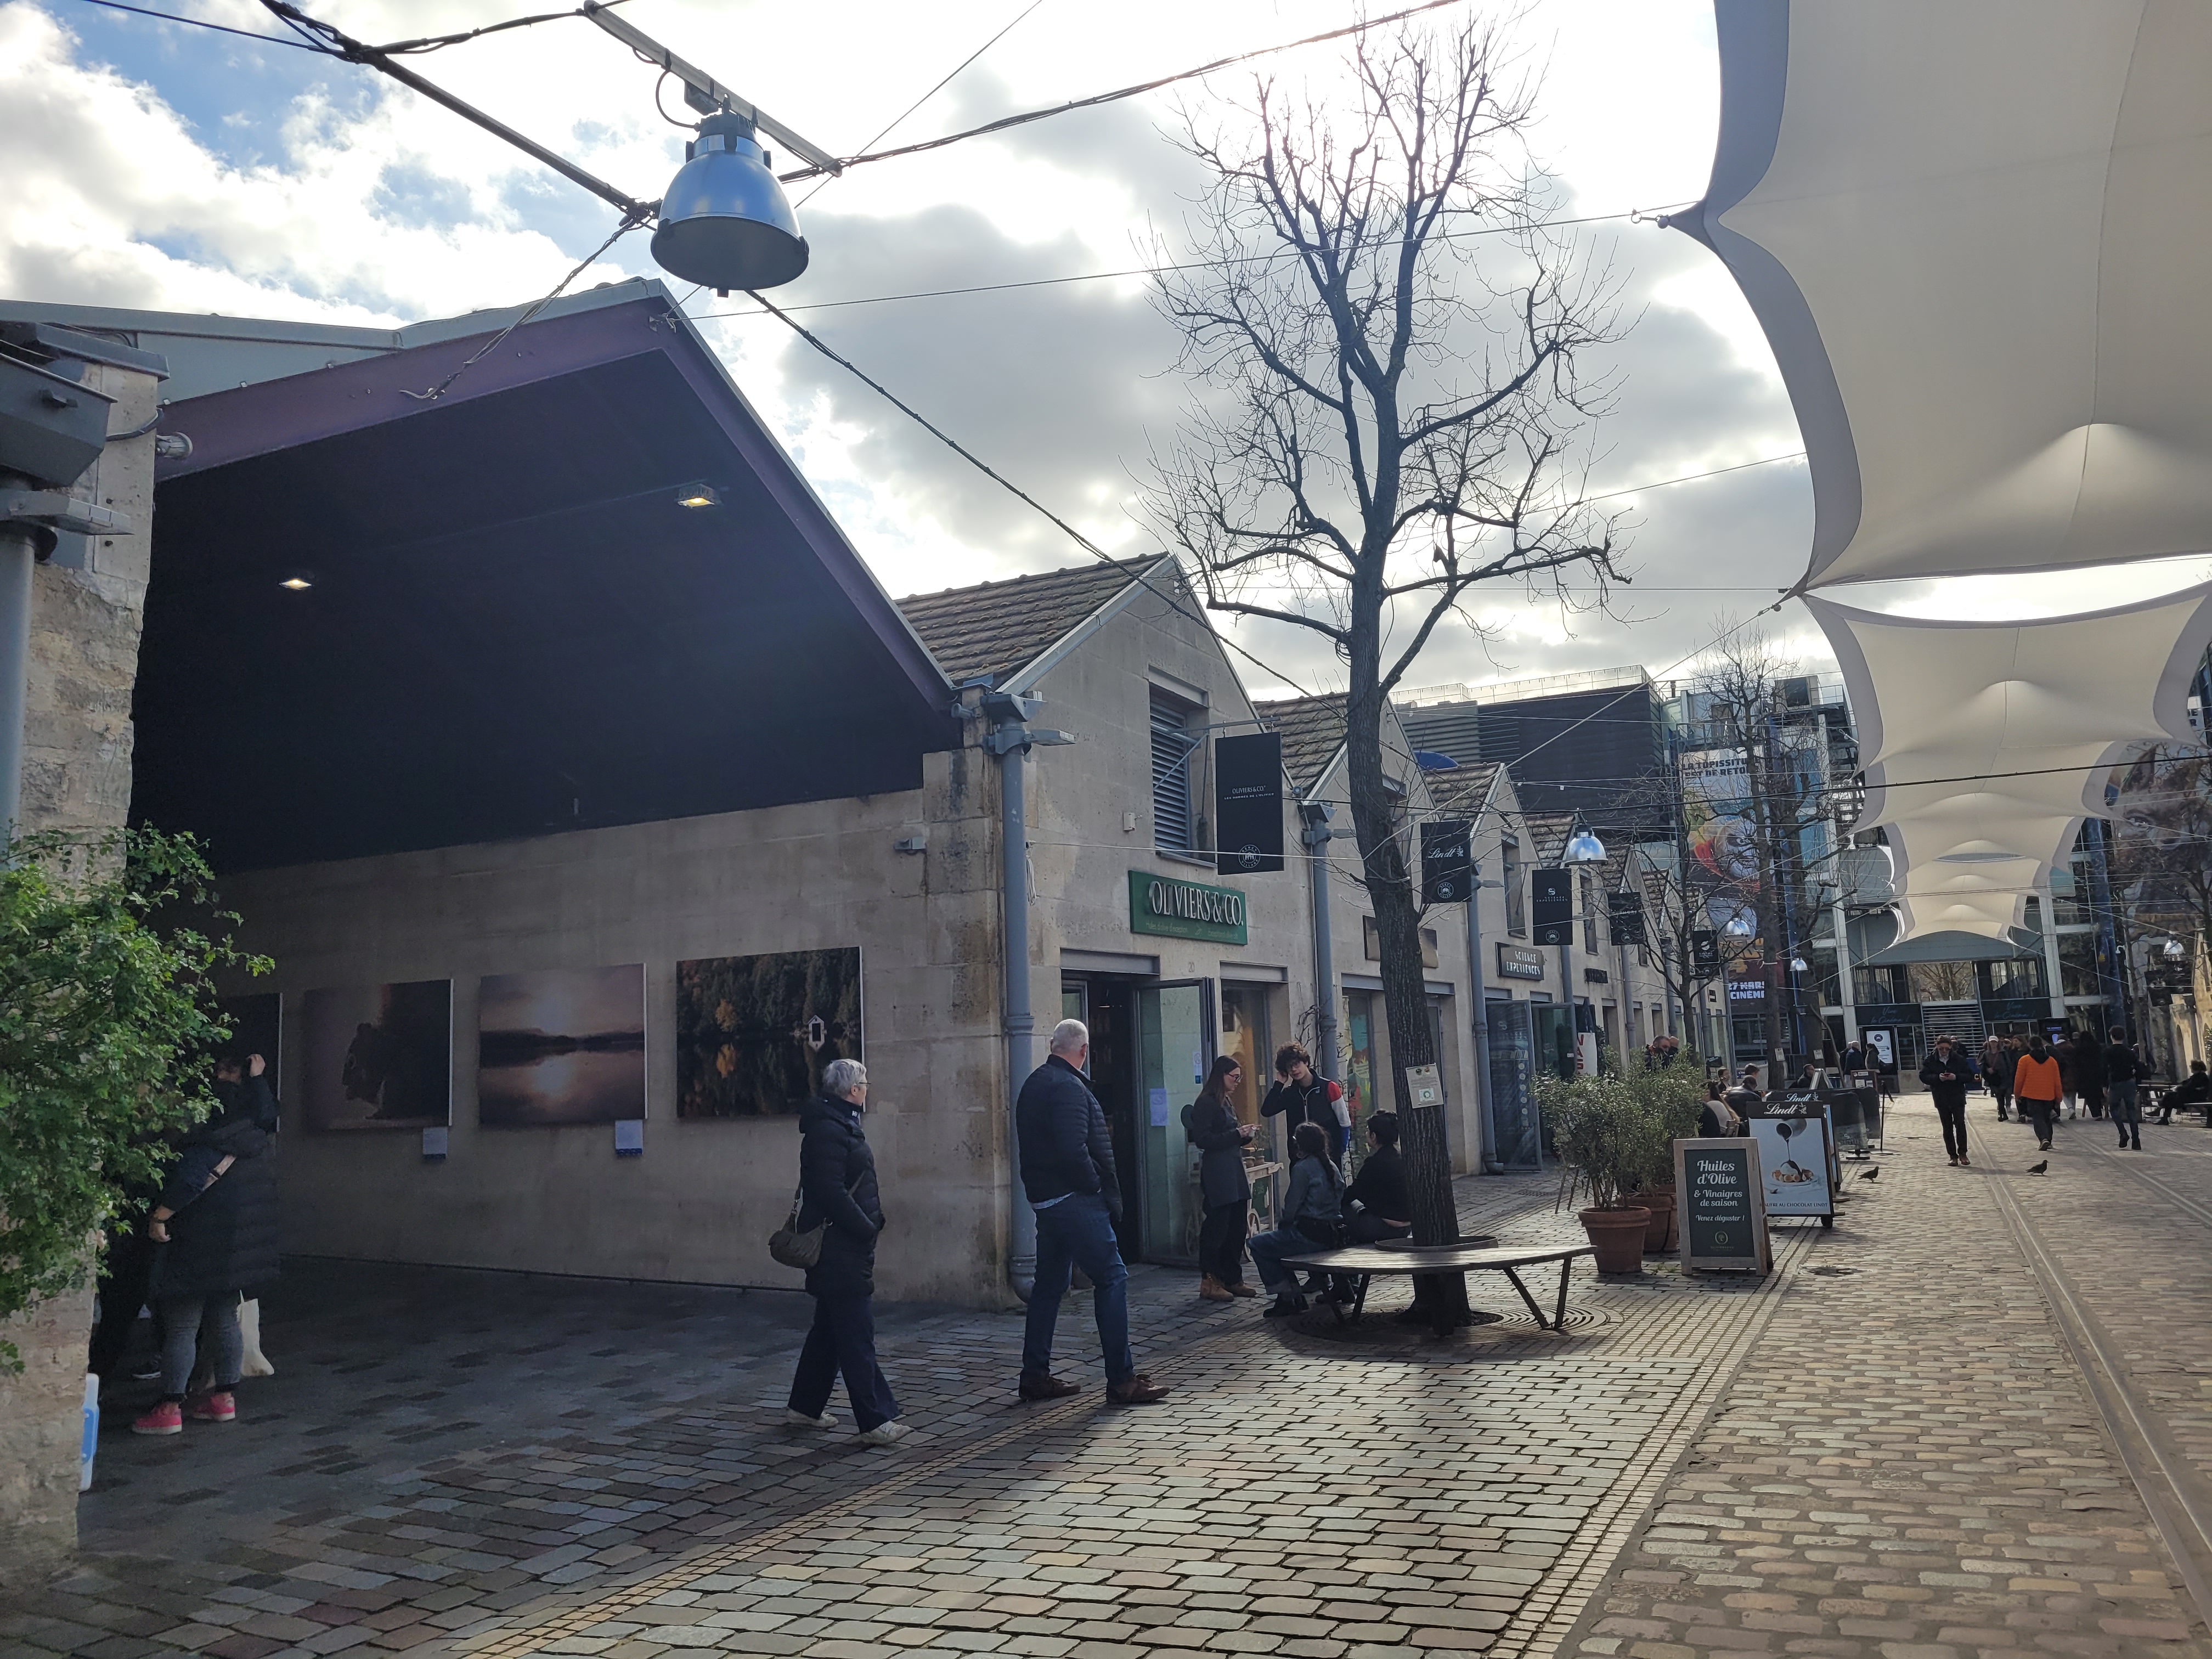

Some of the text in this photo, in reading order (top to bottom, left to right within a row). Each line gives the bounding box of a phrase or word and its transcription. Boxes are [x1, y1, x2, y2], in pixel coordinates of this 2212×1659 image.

[1426, 847, 1456, 859] Lindt
[1515, 950, 1537, 963] SCIENCE
[1506, 961, 1541, 975] EXPERIENCES
[1784, 1093, 1812, 1102] Lindt
[1763, 1103, 1799, 1115] Lindt
[1697, 1160, 1735, 1172] Huiles
[1697, 1173, 1738, 1184] d'Olive
[1694, 1189, 1743, 1200] & Vinaigres
[1714, 1214, 1741, 1223] déguster
